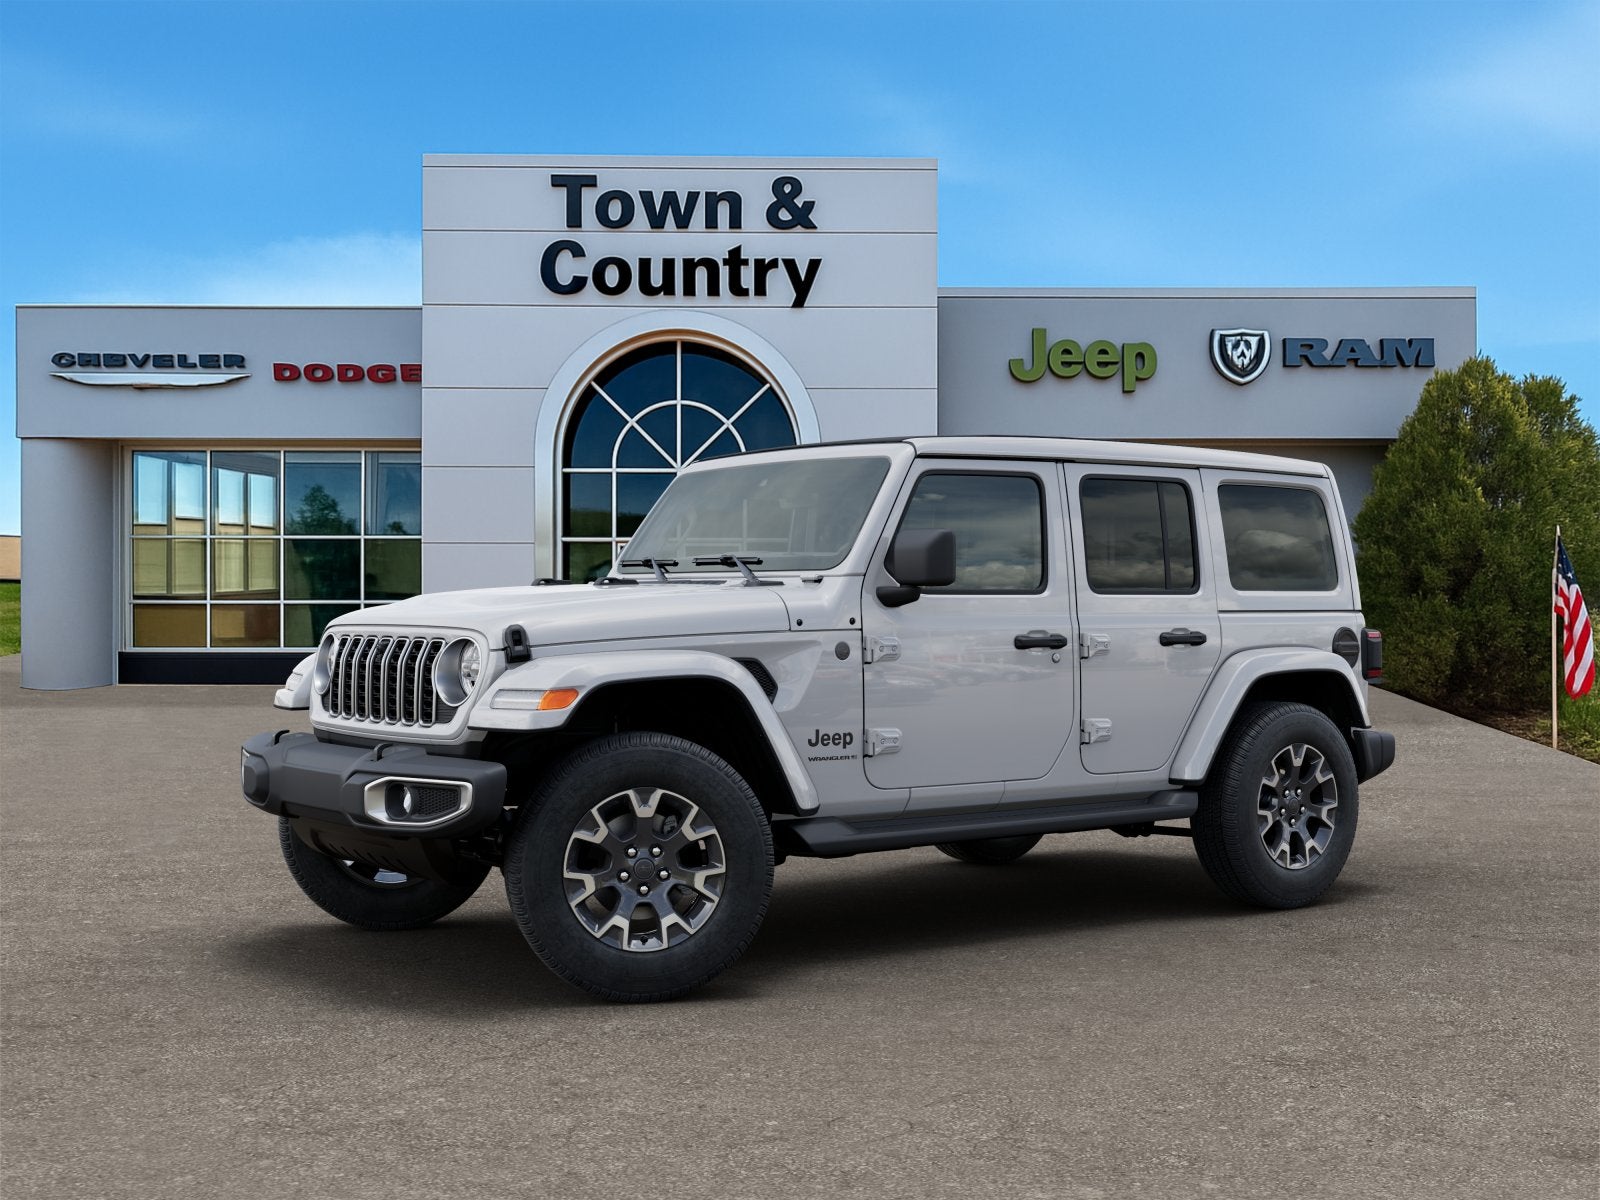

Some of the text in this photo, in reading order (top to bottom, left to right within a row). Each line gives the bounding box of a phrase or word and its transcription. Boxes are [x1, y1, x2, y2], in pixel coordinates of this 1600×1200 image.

[550, 174, 818, 230] Town &
[540, 239, 822, 308] Country
[272, 362, 422, 383] DODGE
[1008, 328, 1158, 393] Jeep
[1282, 337, 1436, 368] RAM
[807, 729, 854, 750] Jeep
